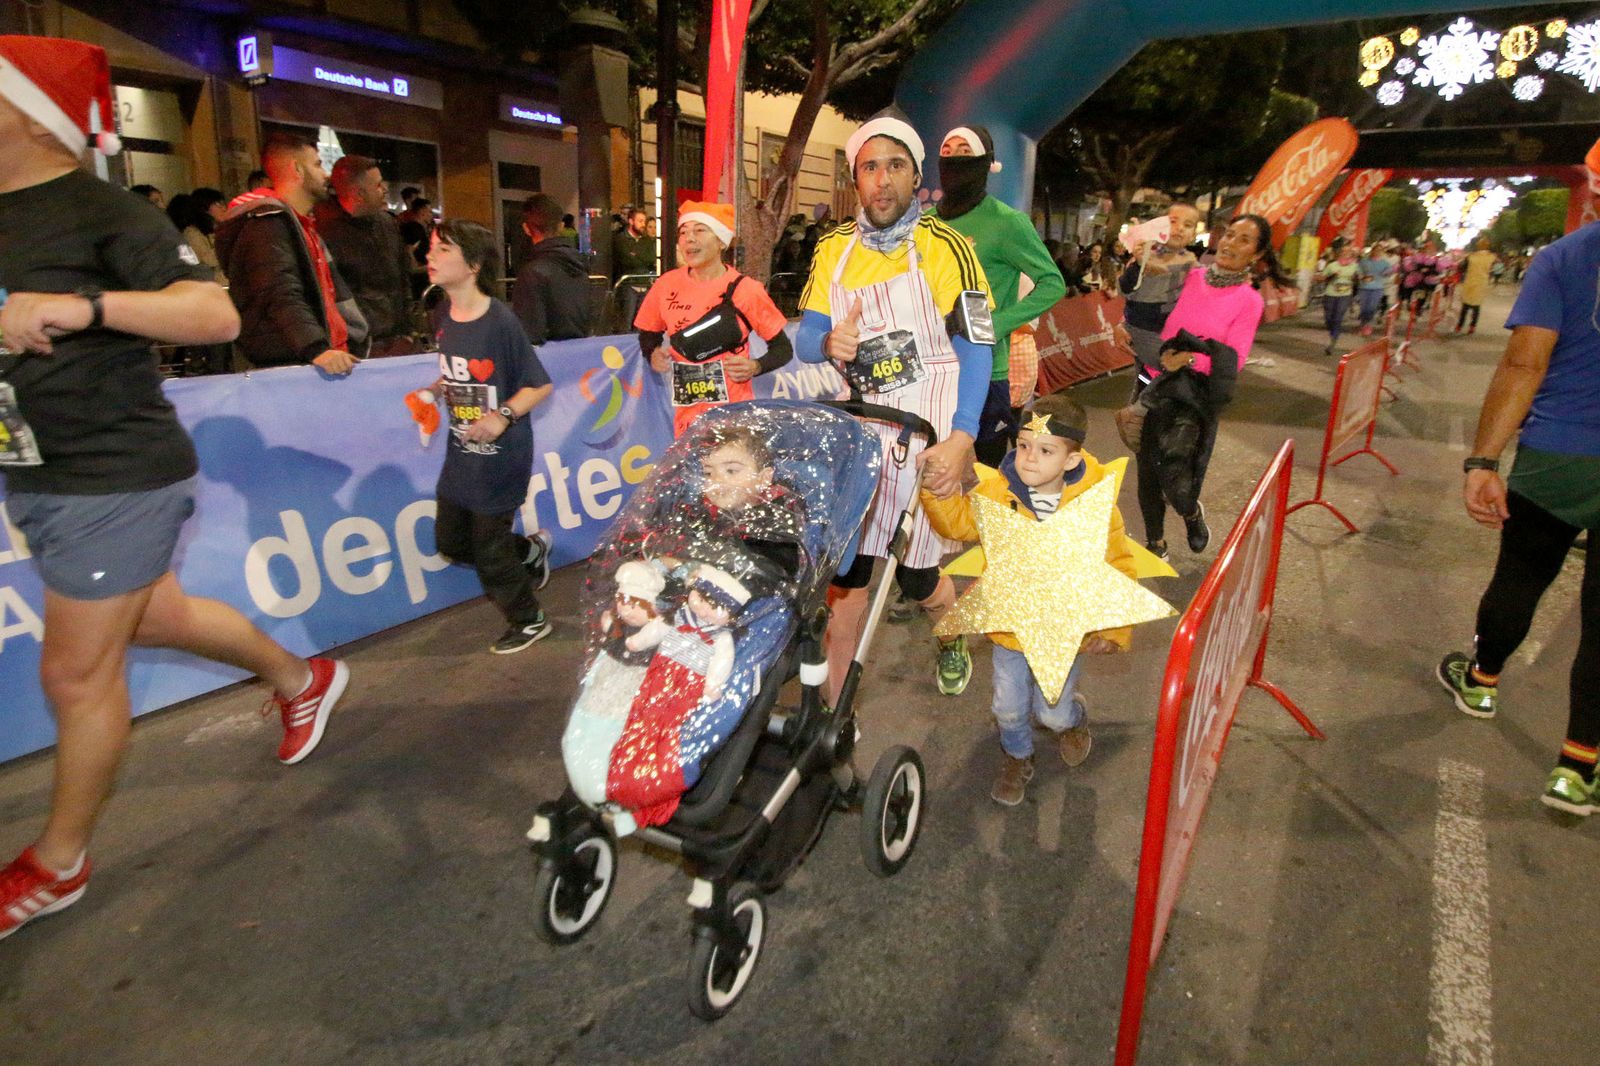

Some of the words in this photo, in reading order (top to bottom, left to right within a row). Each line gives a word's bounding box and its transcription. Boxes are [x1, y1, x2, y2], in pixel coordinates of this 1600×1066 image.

[315, 67, 364, 88] Deutsche
[364, 77, 391, 93] Bank
[512, 106, 547, 123] Deutsche
[872, 357, 903, 379] 466
[685, 379, 717, 395] 1684
[454, 405, 482, 420] 1689
